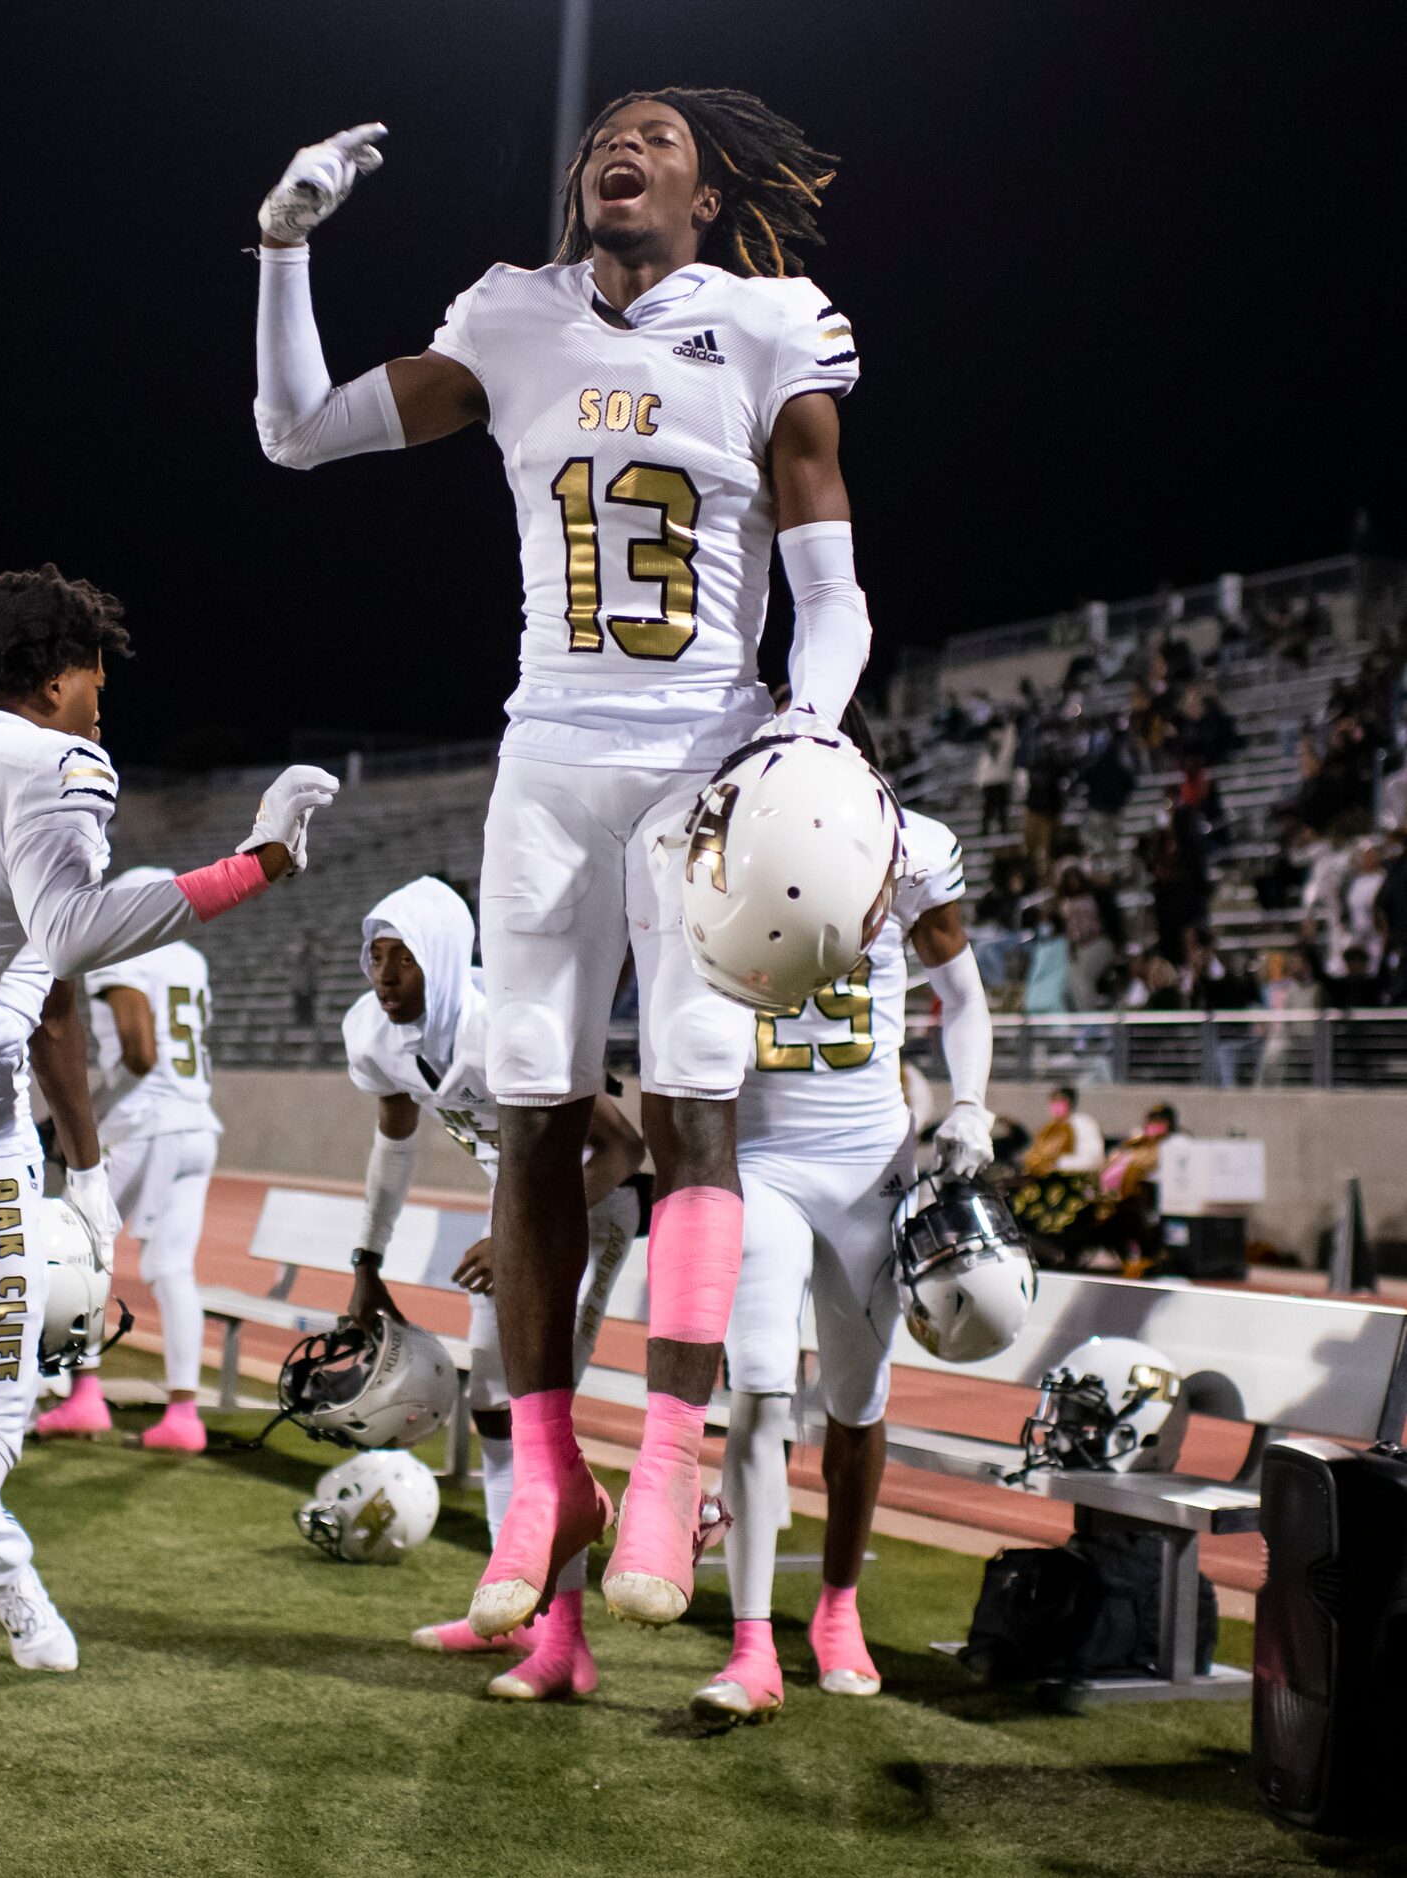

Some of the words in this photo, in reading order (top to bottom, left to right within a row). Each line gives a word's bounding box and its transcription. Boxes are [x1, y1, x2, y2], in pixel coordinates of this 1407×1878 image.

[672, 345, 725, 365] adidas
[578, 388, 662, 436] SOC
[551, 456, 702, 662] 13
[168, 985, 210, 1084] 5
